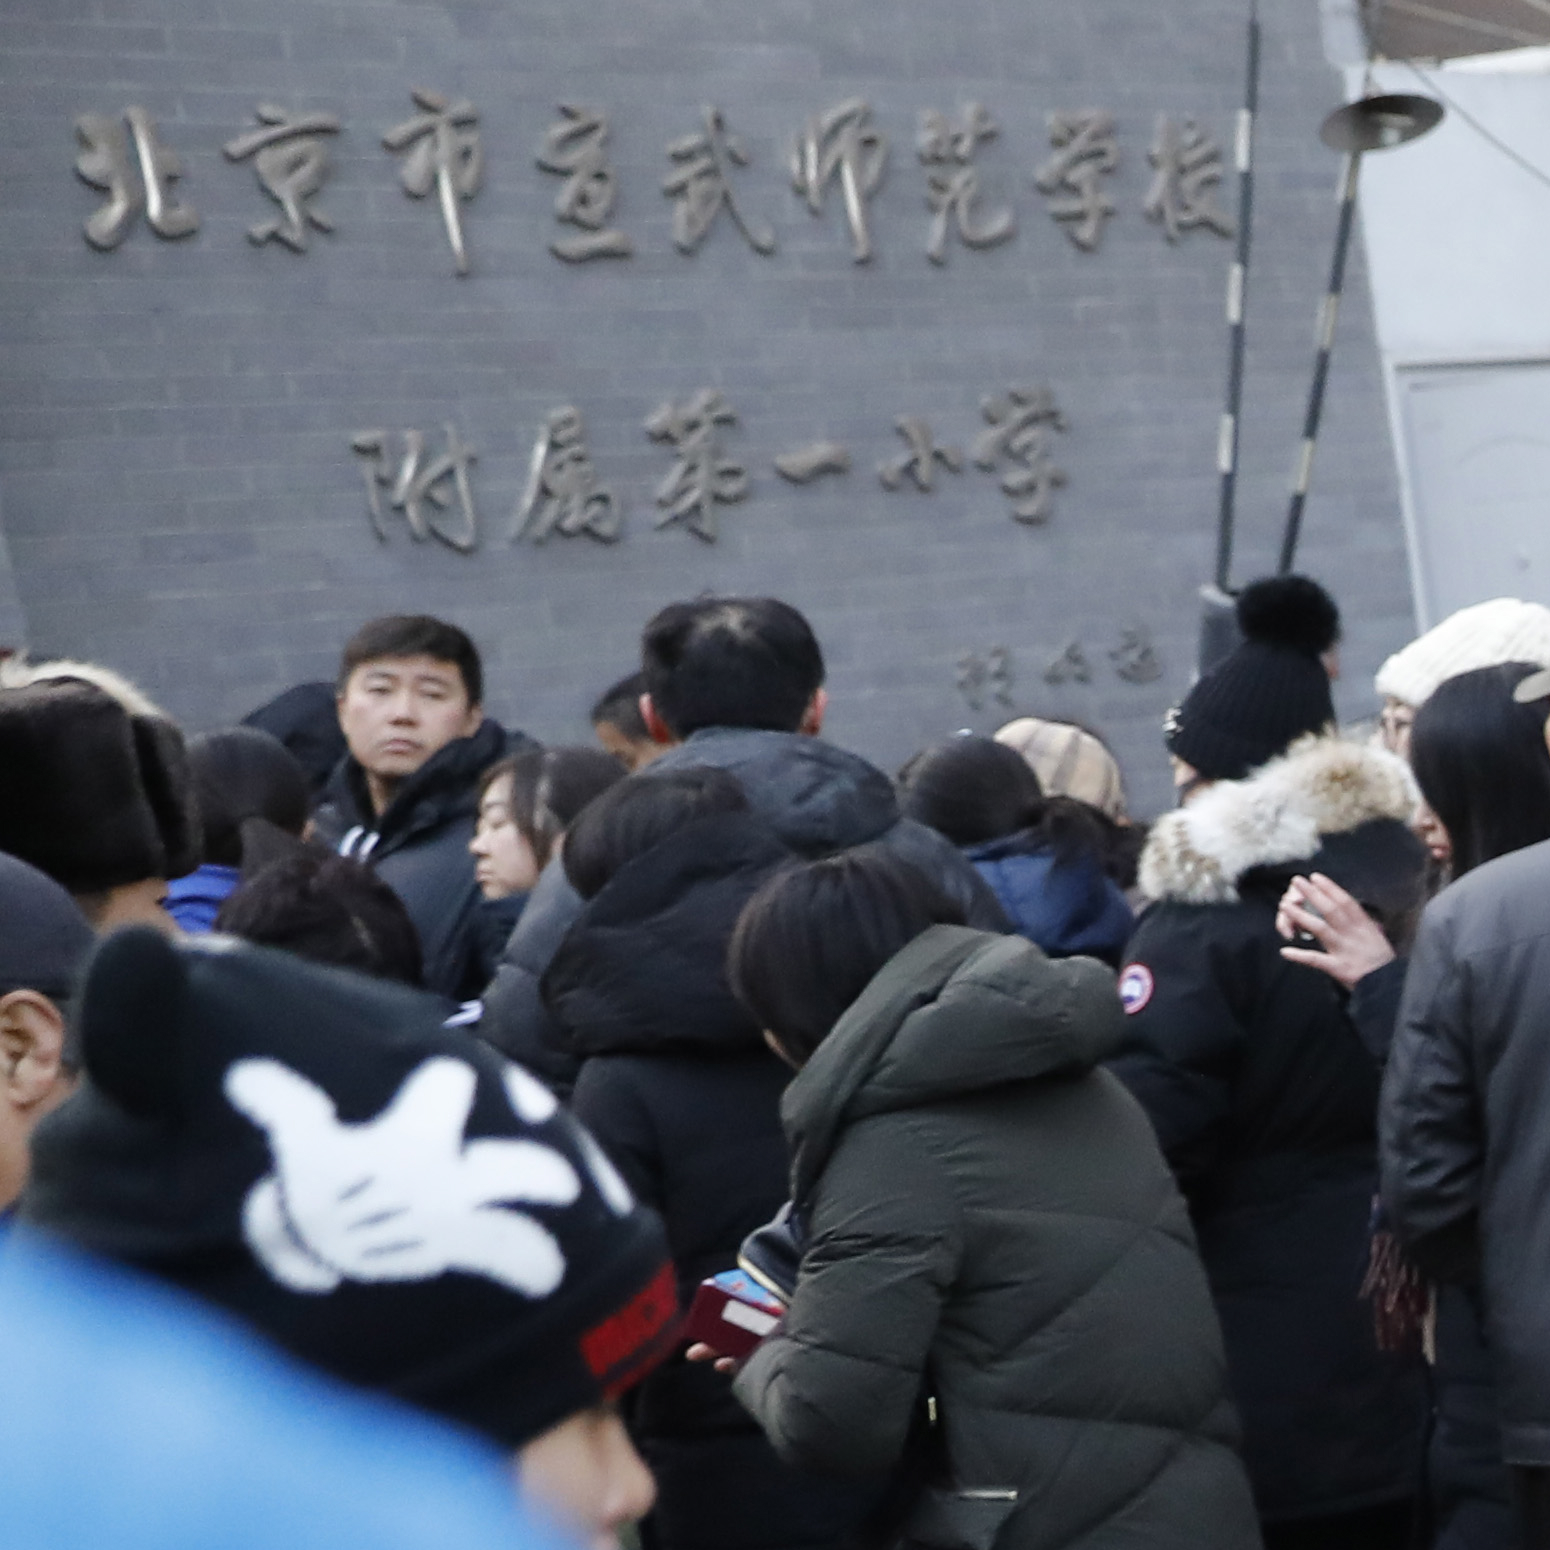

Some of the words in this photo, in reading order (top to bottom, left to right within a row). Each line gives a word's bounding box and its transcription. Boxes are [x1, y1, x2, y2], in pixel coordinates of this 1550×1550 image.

[74, 88, 1236, 278] 北京市宣武师范学校
[351, 388, 1067, 555] 附属第一小学
